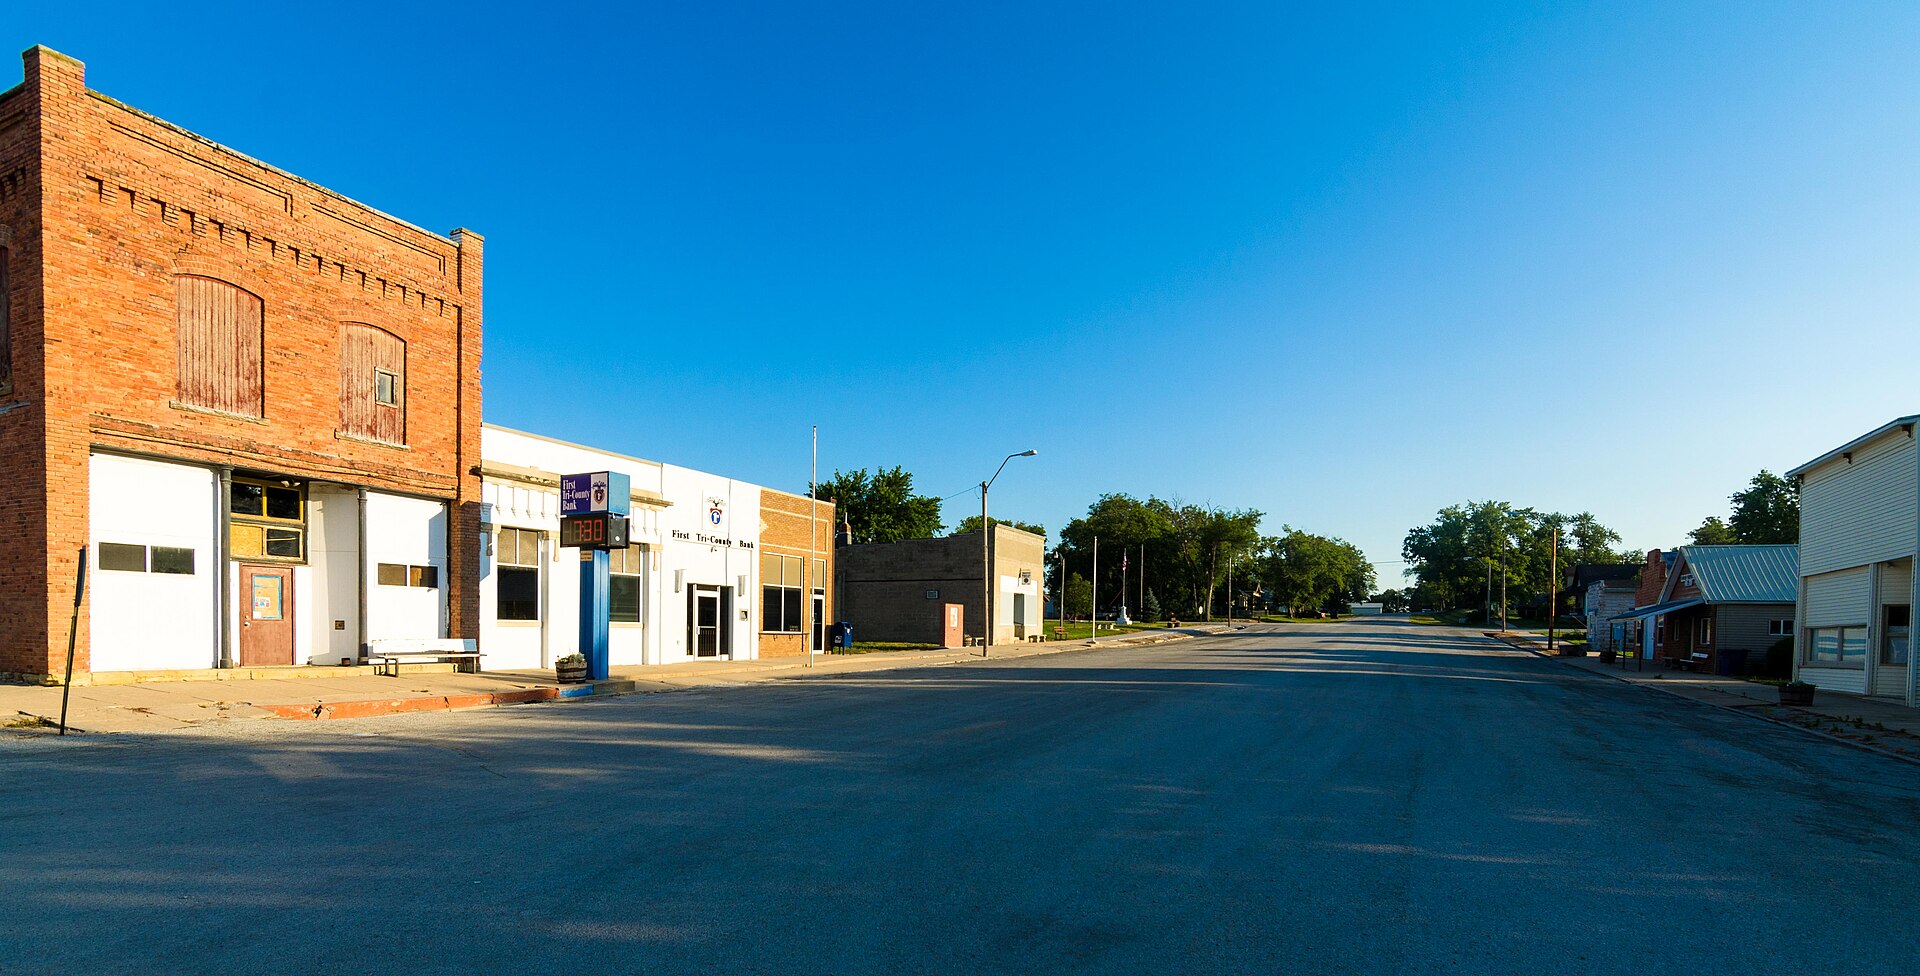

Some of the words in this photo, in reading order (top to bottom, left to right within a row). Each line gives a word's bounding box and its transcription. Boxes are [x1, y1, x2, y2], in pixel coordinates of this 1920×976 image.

[562, 479, 576, 490] First
[562, 490, 590, 501] Tri-County
[562, 500, 577, 511] Bank
[574, 519, 603, 542] 7:30
[672, 529, 690, 540] First
[696, 533, 732, 548] Tri-County
[739, 540, 754, 549] Bank
